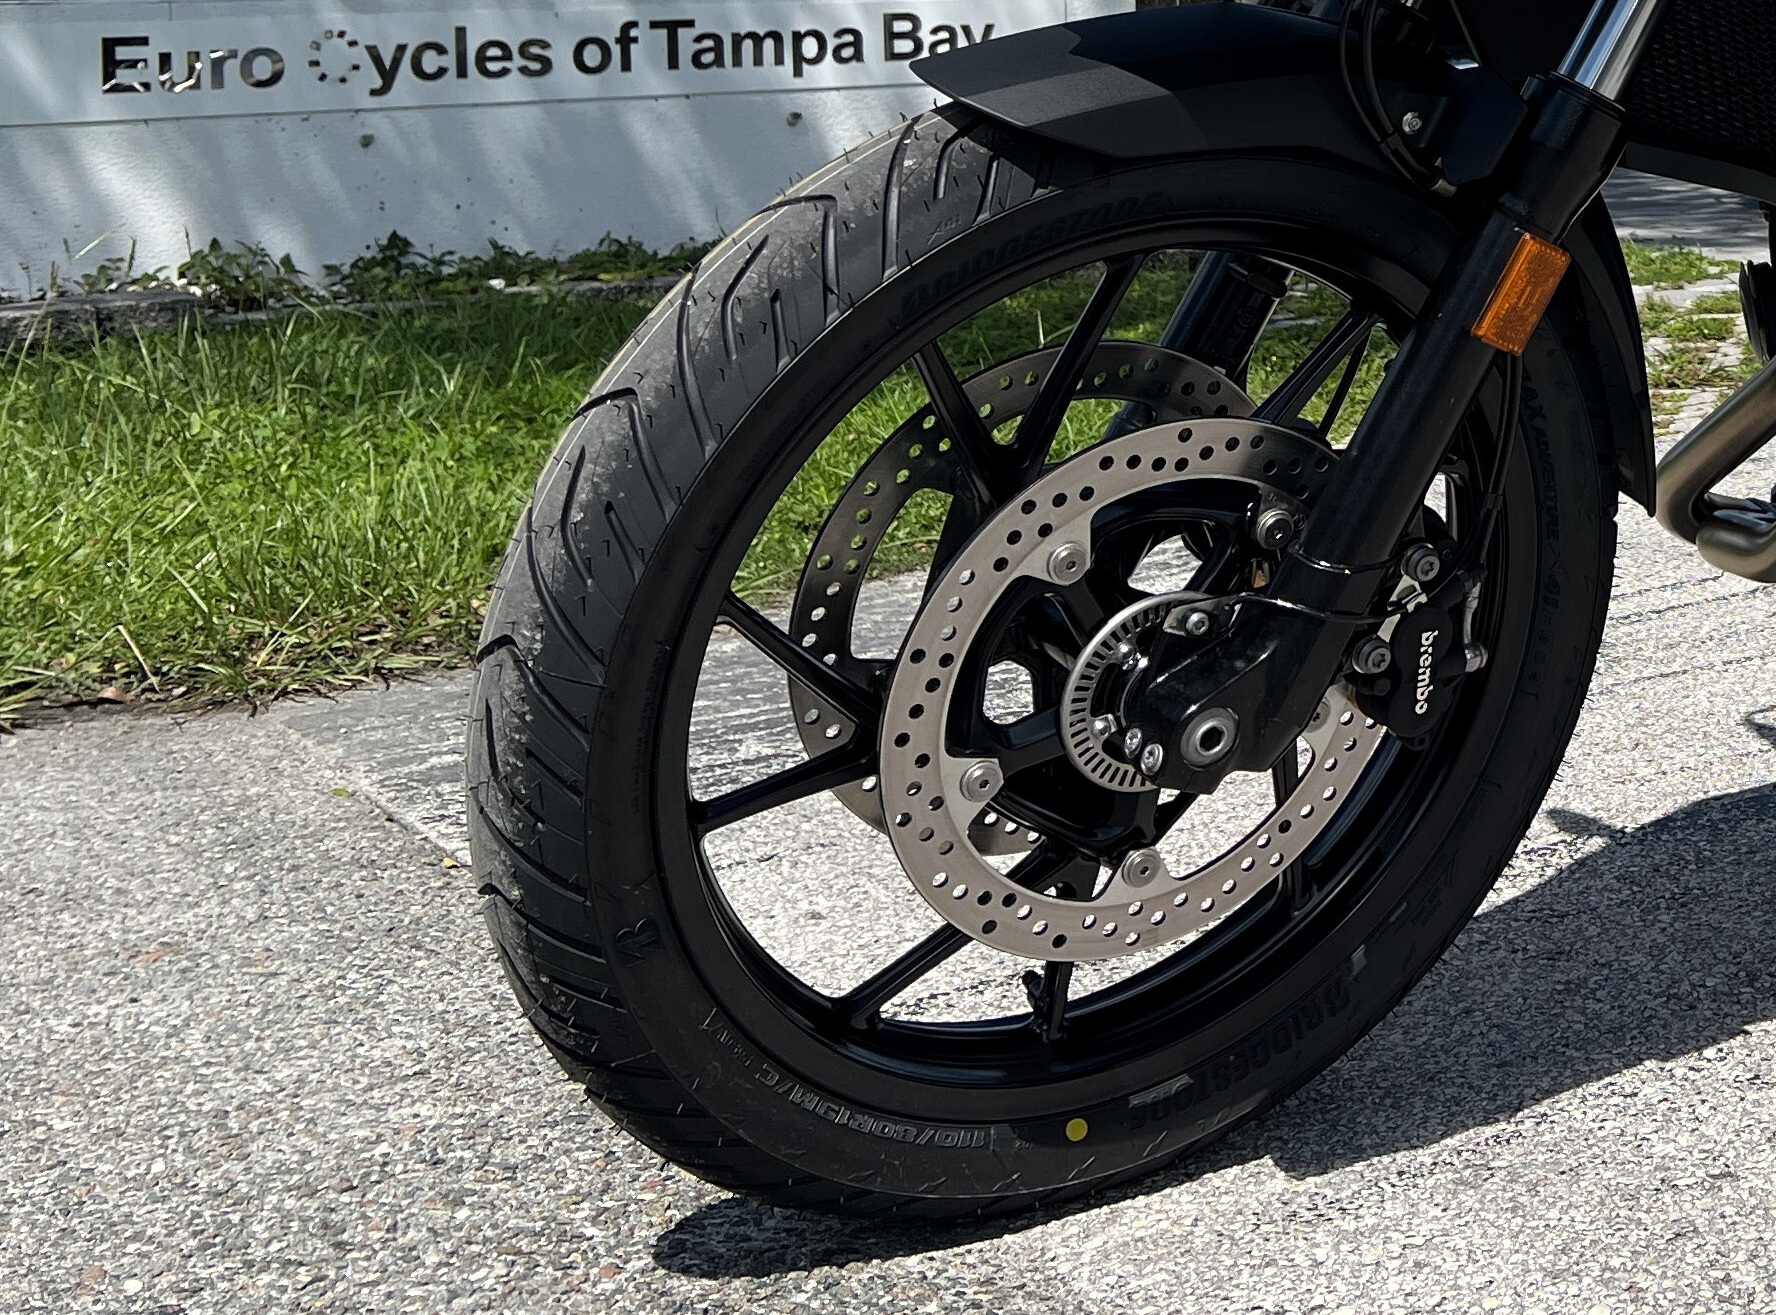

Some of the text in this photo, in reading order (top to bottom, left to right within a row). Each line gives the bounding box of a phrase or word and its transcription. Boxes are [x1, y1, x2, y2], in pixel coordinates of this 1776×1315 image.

[100, 35, 286, 95] Euro
[572, 19, 640, 76] of
[648, 18, 865, 79] Tampa
[1414, 630, 1439, 715] brembo
